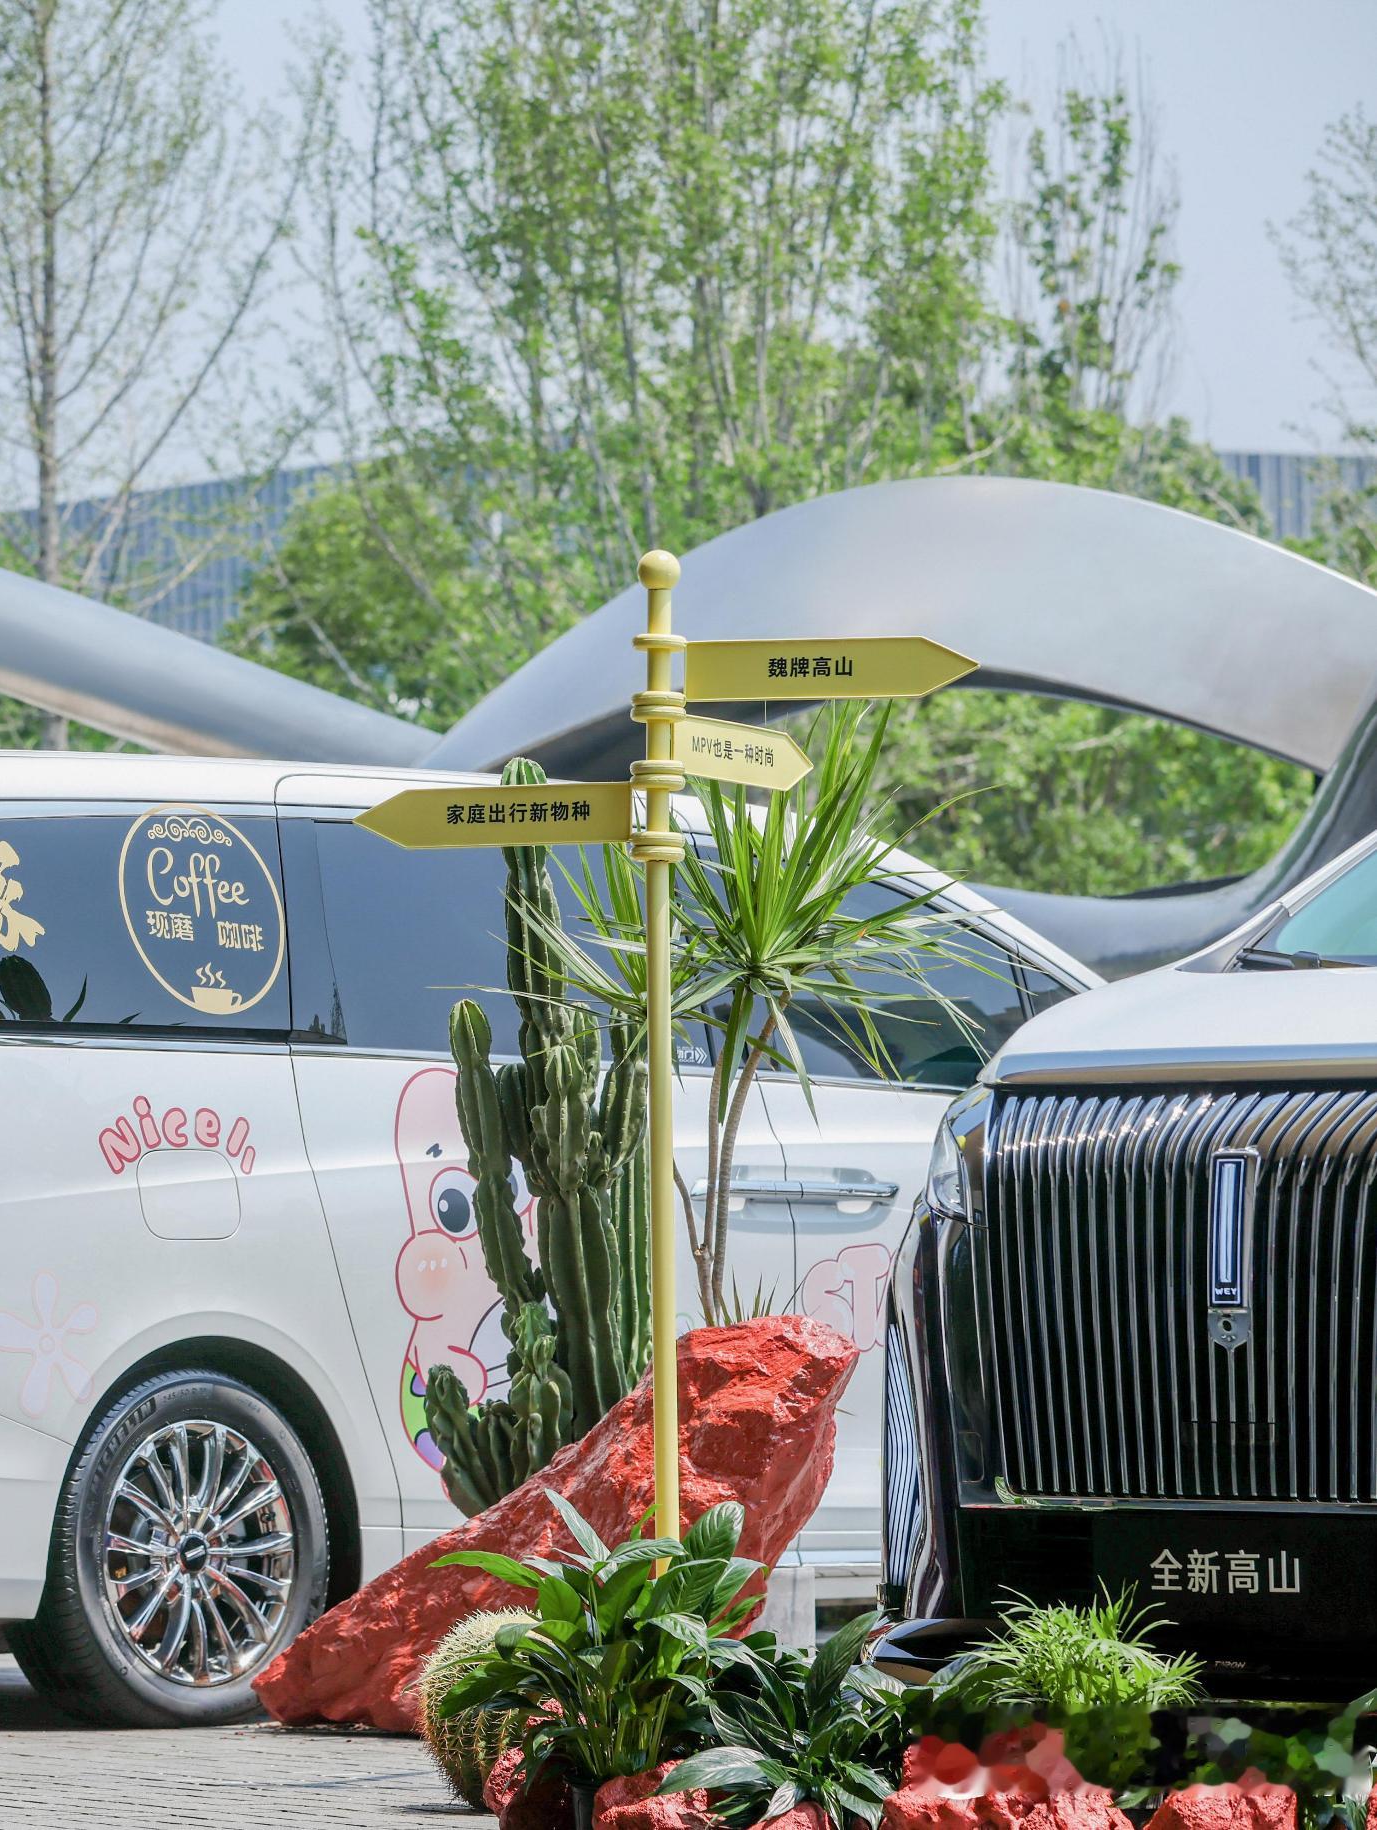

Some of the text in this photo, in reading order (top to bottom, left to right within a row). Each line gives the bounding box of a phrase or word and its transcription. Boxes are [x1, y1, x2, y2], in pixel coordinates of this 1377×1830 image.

[767, 656, 854, 679] 魏牌高山
[692, 736, 774, 767] MPV也是一种时尚
[446, 800, 591, 825] 家庭出行新物种
[146, 847, 250, 919] Coffee
[146, 910, 264, 951] 现磨 咖啡
[1215, 1287, 1237, 1296] WEY
[1150, 1548, 1301, 1594] 全新高山
